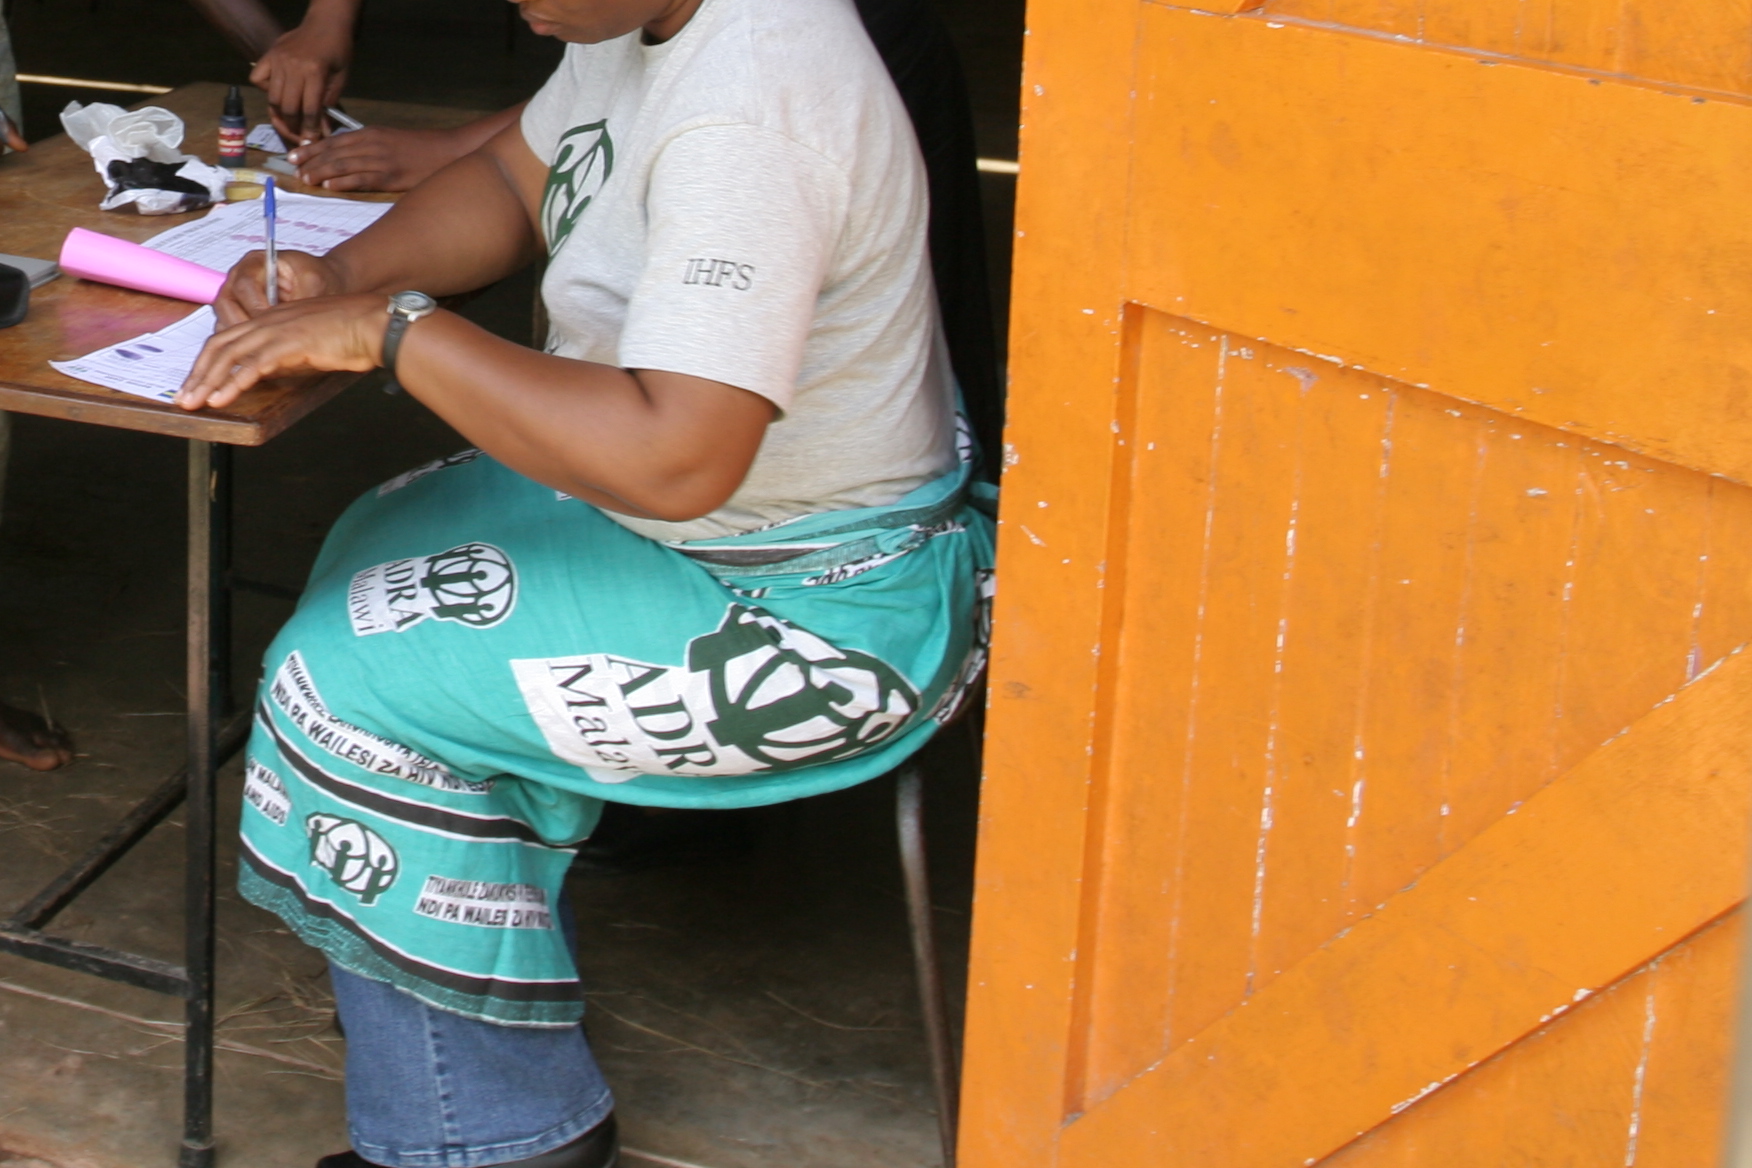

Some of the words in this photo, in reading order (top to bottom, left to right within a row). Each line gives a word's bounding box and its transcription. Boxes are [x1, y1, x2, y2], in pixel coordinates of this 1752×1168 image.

[682, 258, 756, 291] IHFS
[604, 655, 718, 777] ADR
[308, 720, 378, 769] WAILESI
[376, 759, 401, 776] ZA
